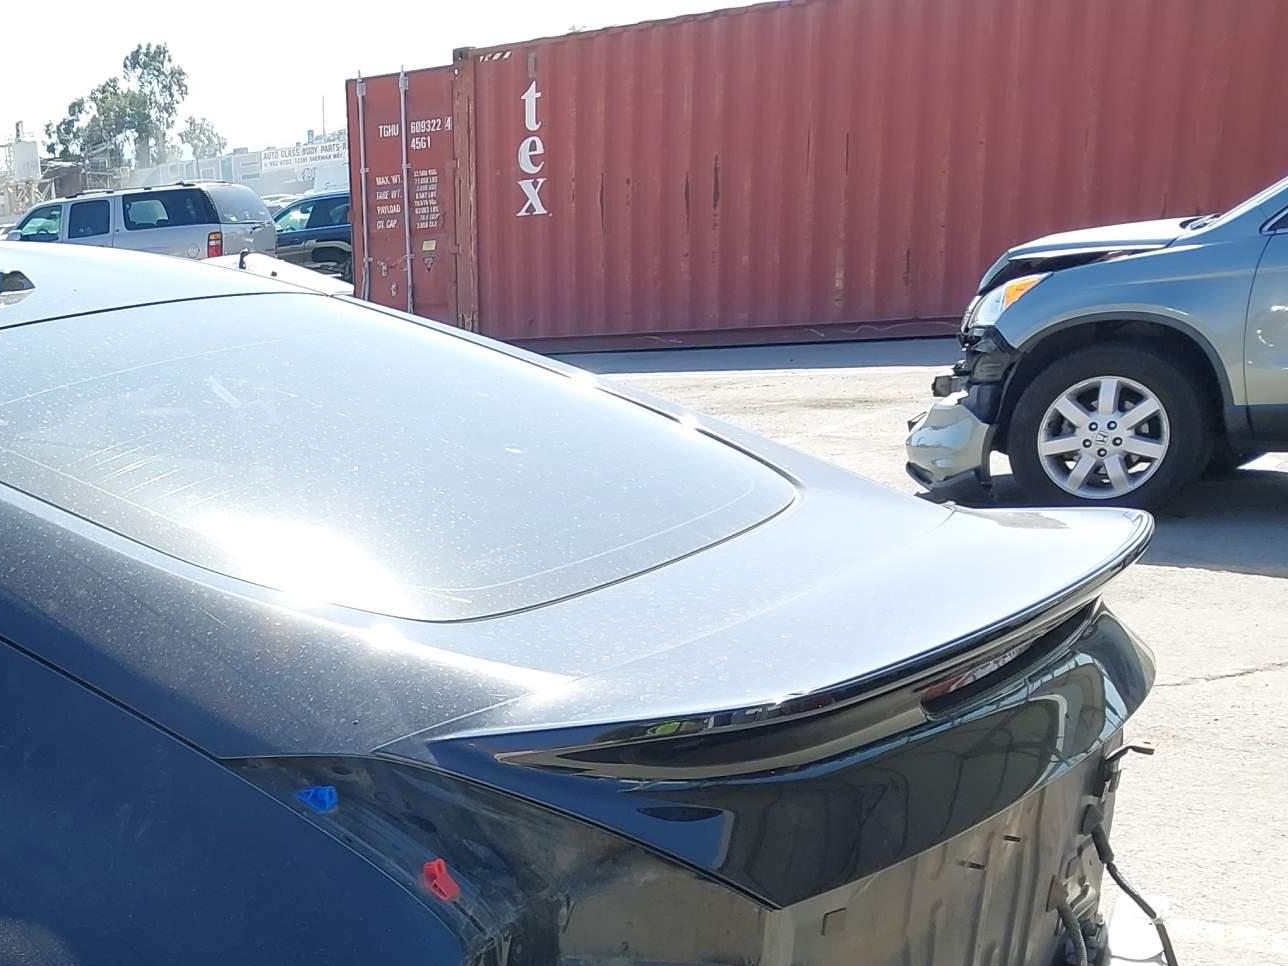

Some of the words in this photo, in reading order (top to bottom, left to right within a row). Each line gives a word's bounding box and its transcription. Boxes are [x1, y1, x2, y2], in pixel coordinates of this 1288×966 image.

[378, 123, 400, 138] TGHU
[410, 118, 442, 134] 609322
[444, 116, 452, 131] 4
[410, 135, 431, 150] 45G1
[516, 80, 549, 217] tex
[263, 151, 279, 161] AUTO
[376, 204, 401, 215] PAYLOAD
